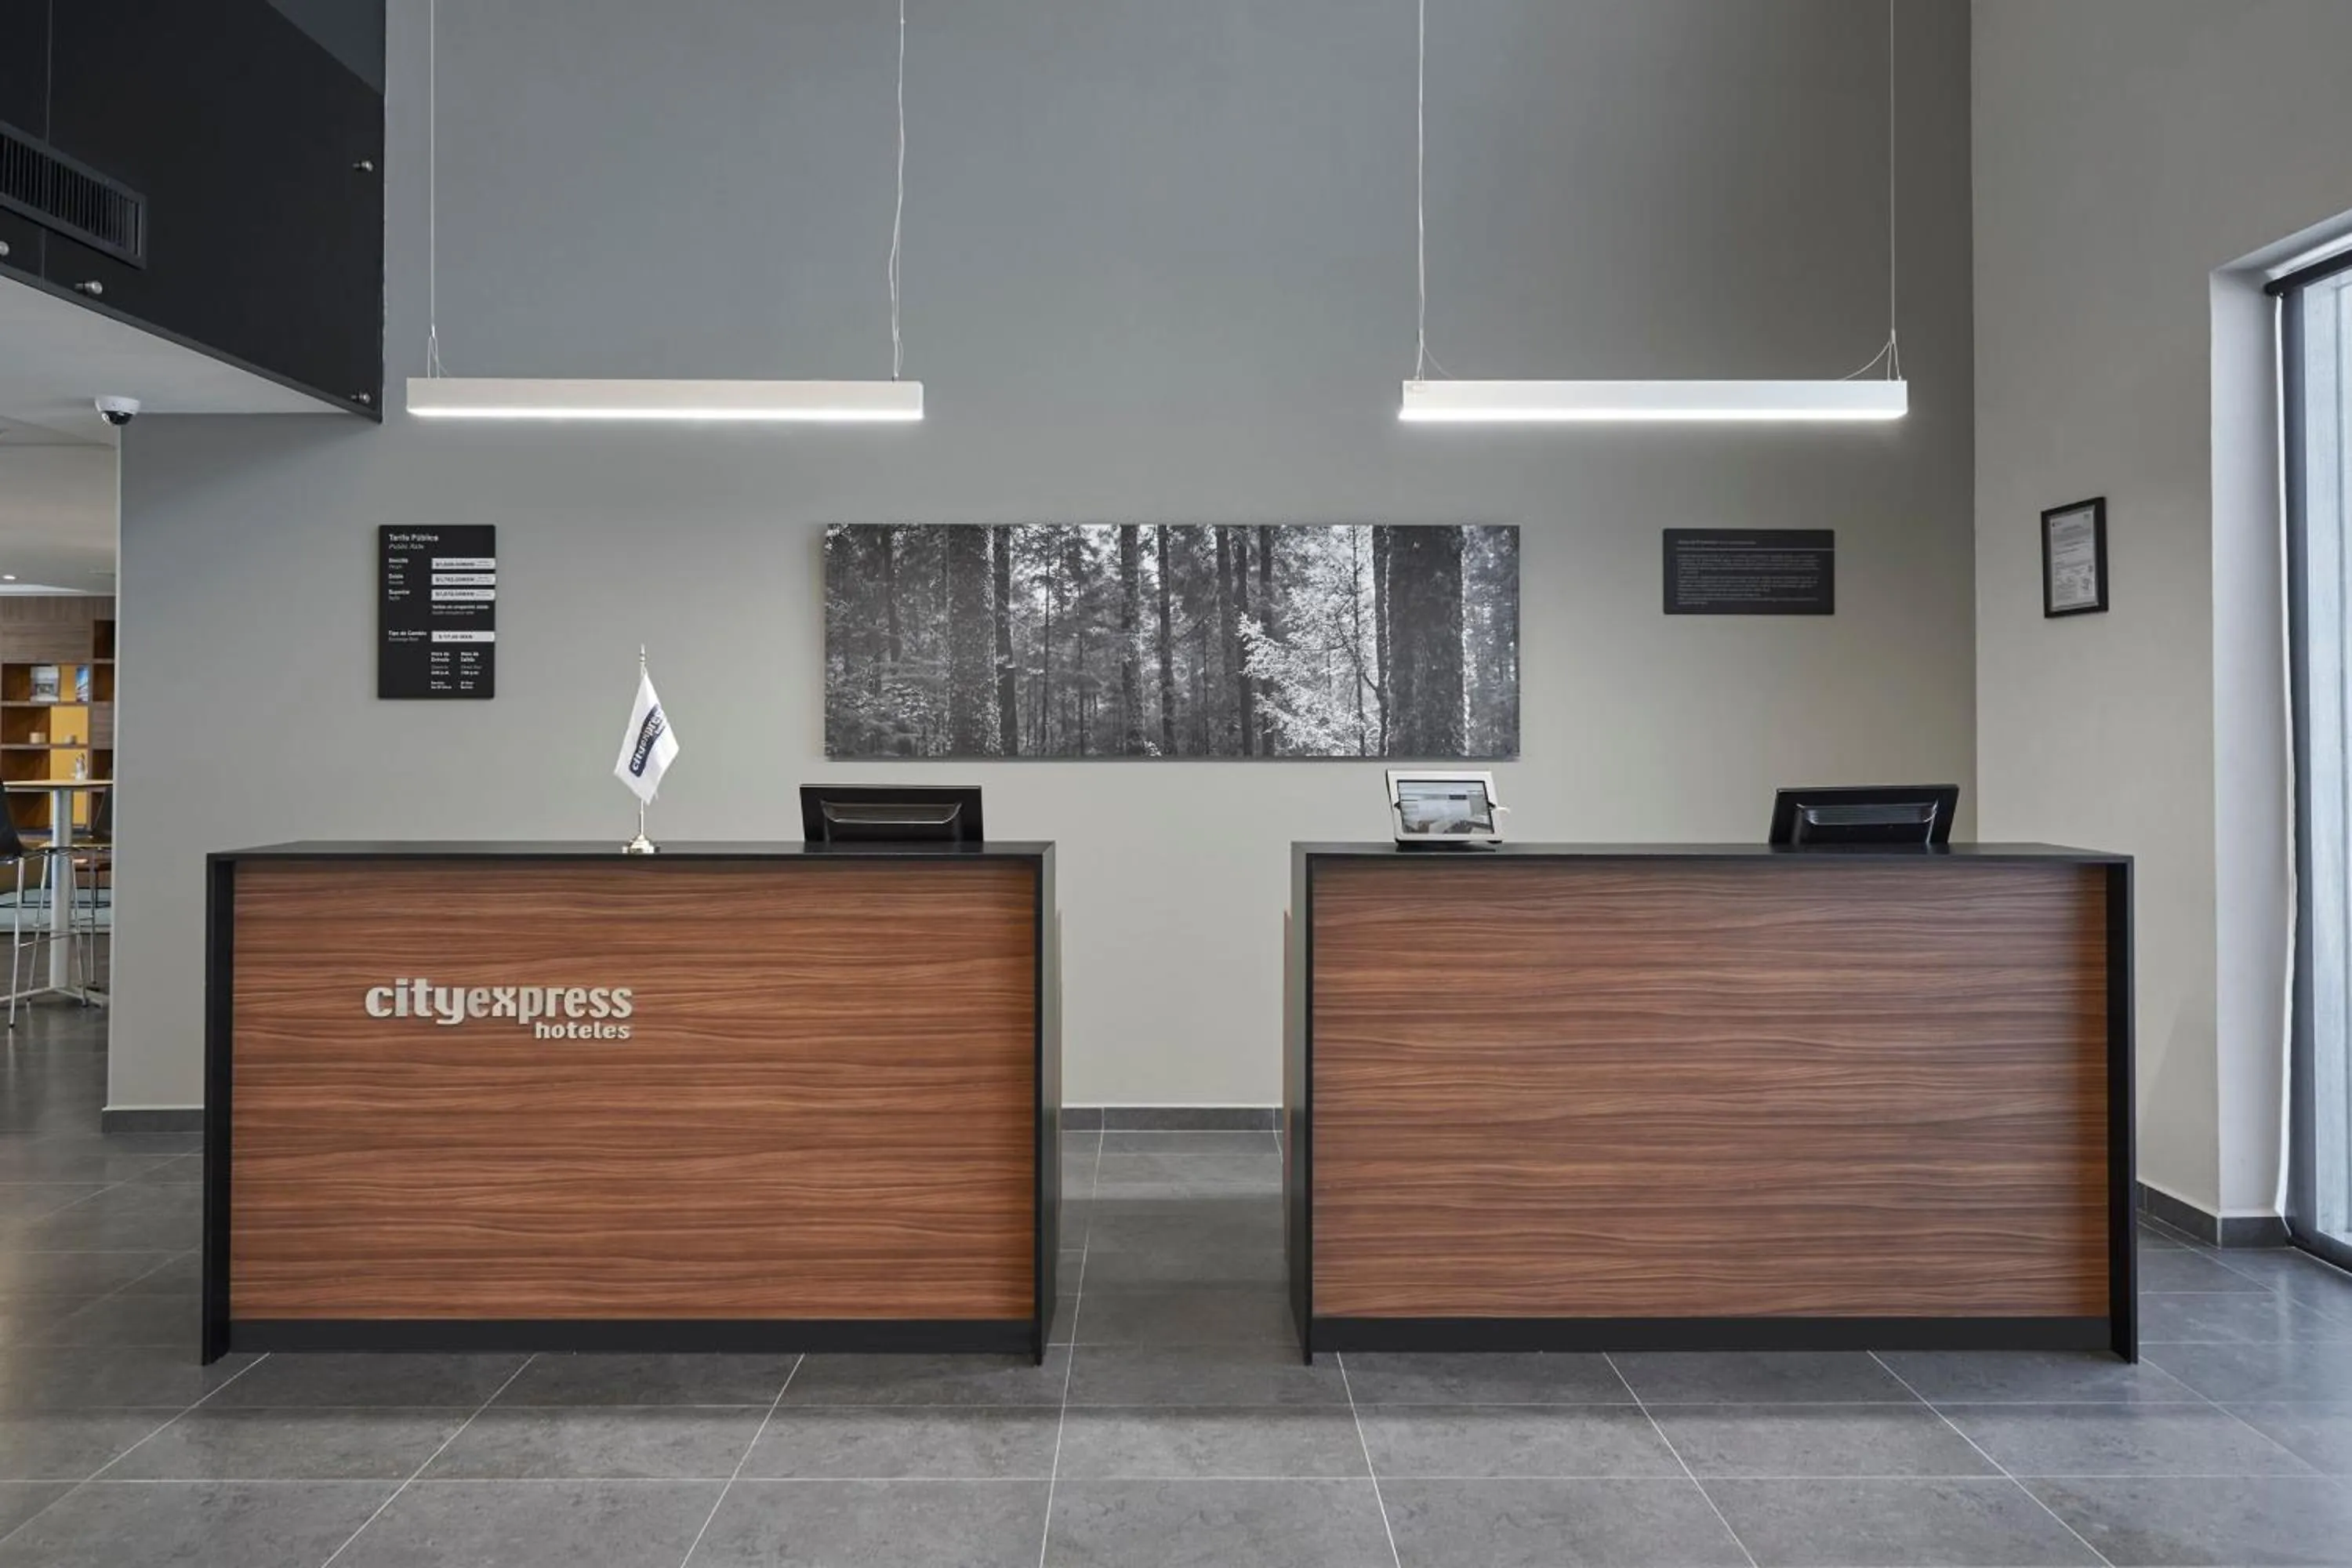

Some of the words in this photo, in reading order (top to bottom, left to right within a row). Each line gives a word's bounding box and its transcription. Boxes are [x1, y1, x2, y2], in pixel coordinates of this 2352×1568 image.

[388, 533, 410, 542] Tarifa
[411, 533, 439, 542] Pública
[365, 978, 633, 1025] cityexpress
[535, 1022, 631, 1040] hoteles
